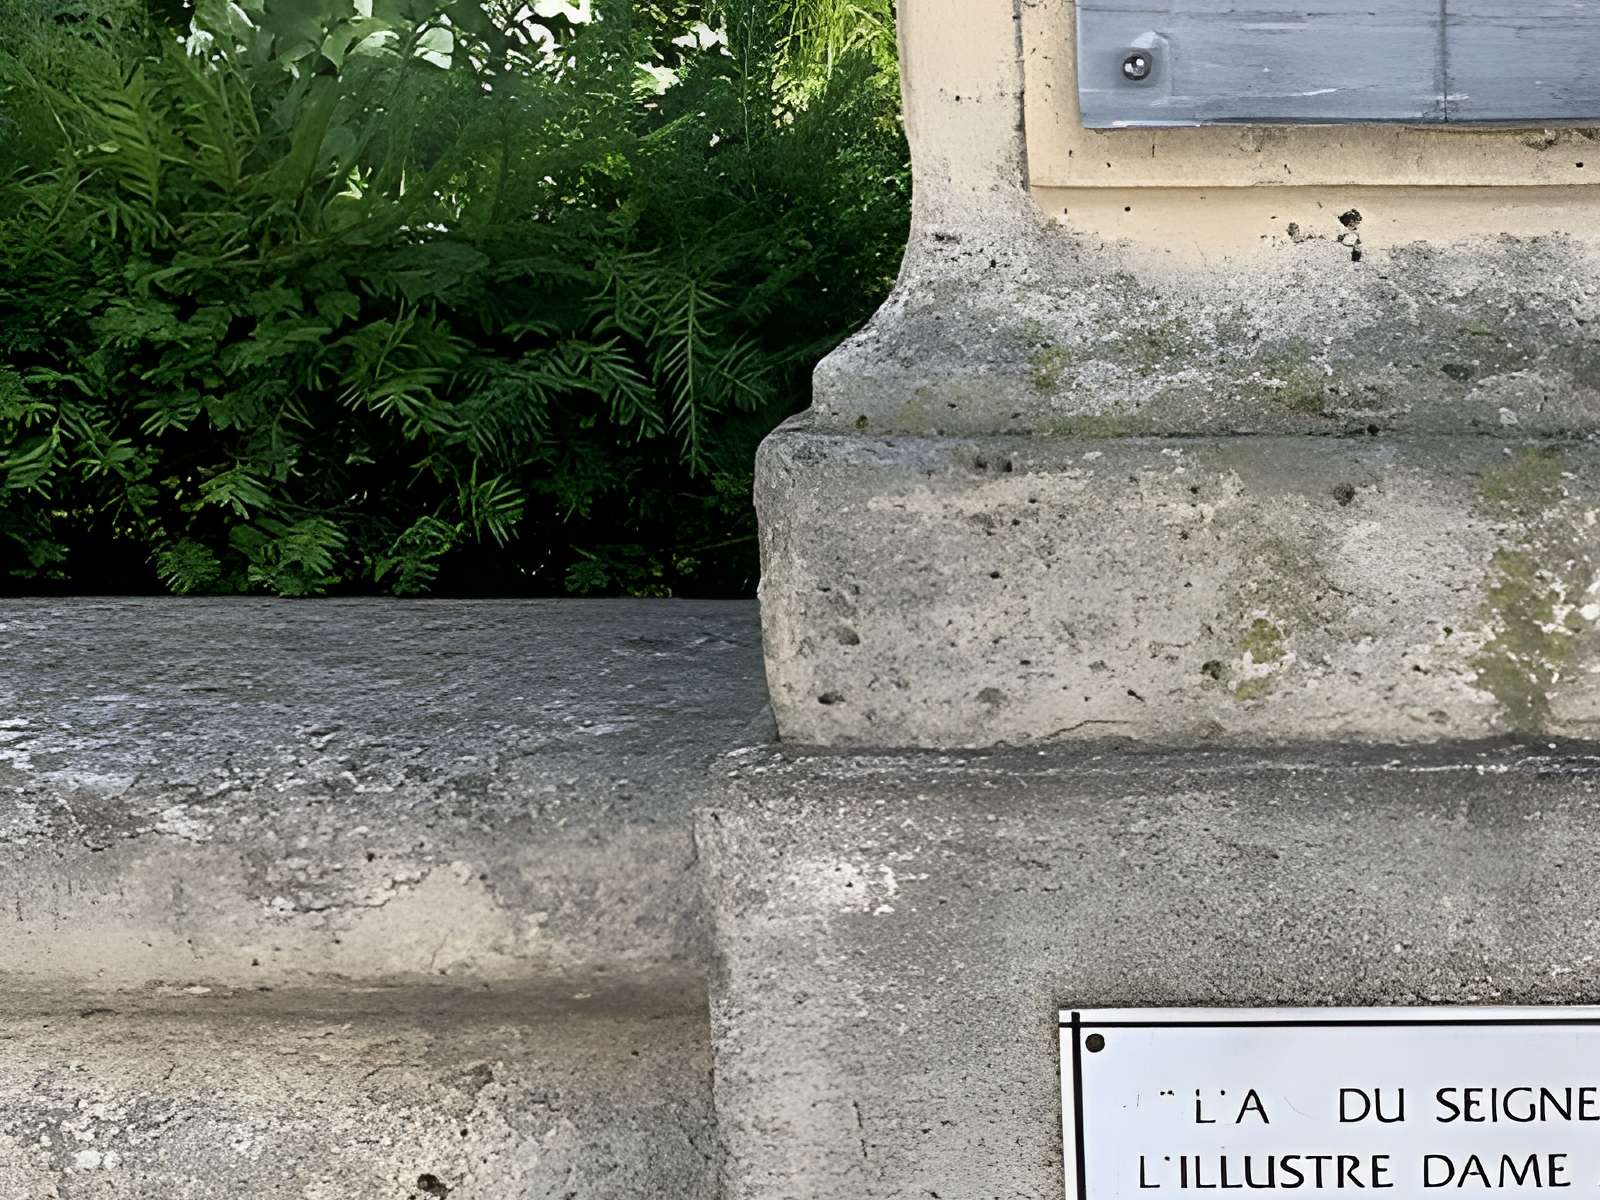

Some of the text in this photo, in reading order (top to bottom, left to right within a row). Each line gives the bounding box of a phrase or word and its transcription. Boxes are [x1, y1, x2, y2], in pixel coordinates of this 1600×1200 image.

[1339, 1087, 1405, 1124] DU
[1139, 1154, 1394, 1189] L'ILLUSTRE
[1423, 1153, 1571, 1189] DAME
